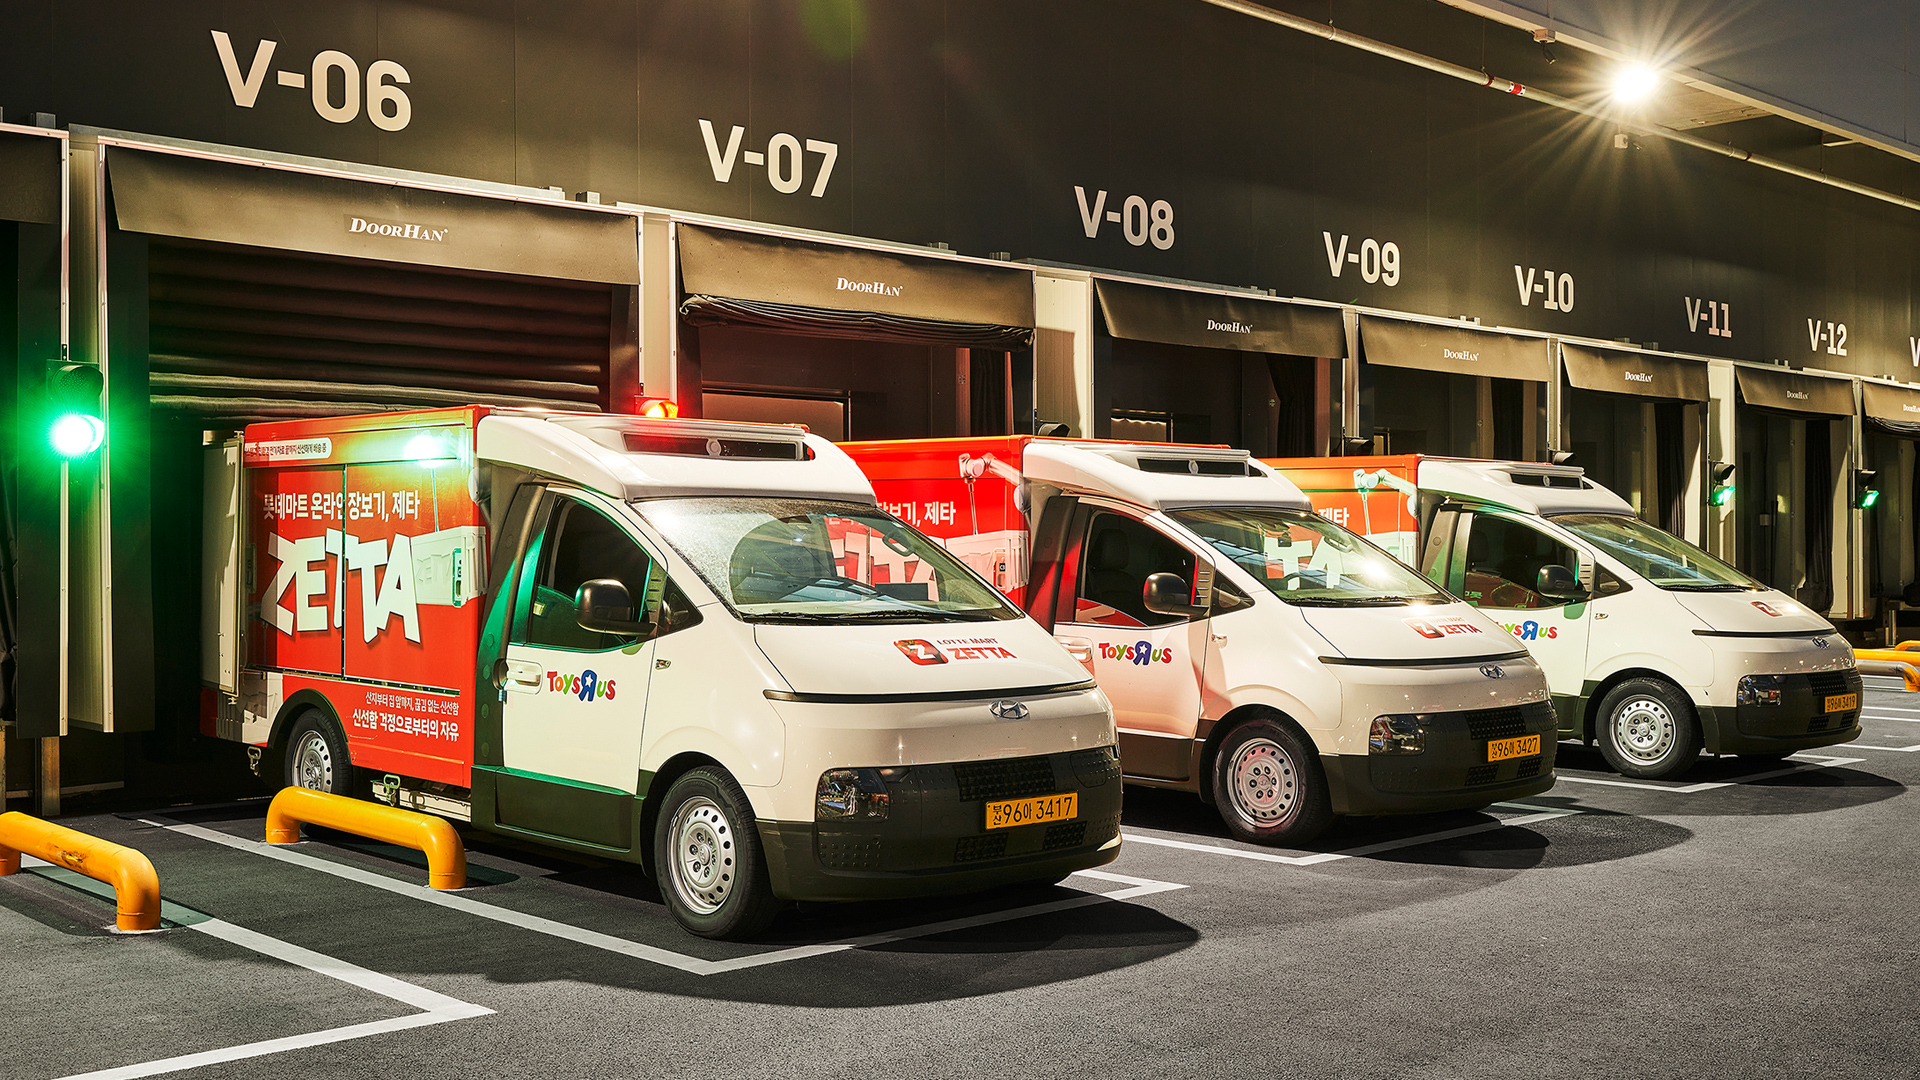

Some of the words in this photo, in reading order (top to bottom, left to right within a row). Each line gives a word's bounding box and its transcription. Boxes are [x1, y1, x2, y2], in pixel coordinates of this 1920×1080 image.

[210, 29, 412, 132] V-06
[698, 119, 838, 198] V-07
[1074, 185, 1176, 250] V-08
[1322, 231, 1400, 287] V-09
[1514, 264, 1575, 313] V-10
[1684, 296, 1732, 338] V-11
[1807, 318, 1848, 357] V-12
[263, 492, 309, 520] 롯데마트
[347, 490, 389, 523] 장보기,
[391, 489, 421, 521] 제타
[923, 500, 956, 526] 제타
[260, 527, 421, 644] ZETTA
[1438, 623, 1483, 634] ZETTA
[946, 646, 1018, 660] ZETTA
[365, 691, 388, 707] 산지부터
[388, 694, 395, 708] 집
[427, 699, 440, 714] 없는
[440, 701, 460, 716] 신선함
[352, 708, 378, 730] 신선함
[379, 712, 439, 740] 걱정으로부터의
[440, 721, 460, 742] 자유
[1516, 737, 1538, 755] 3427
[992, 804, 1002, 826] 부산
[1003, 802, 1033, 824] 96아
[1036, 796, 1073, 820] 3417
